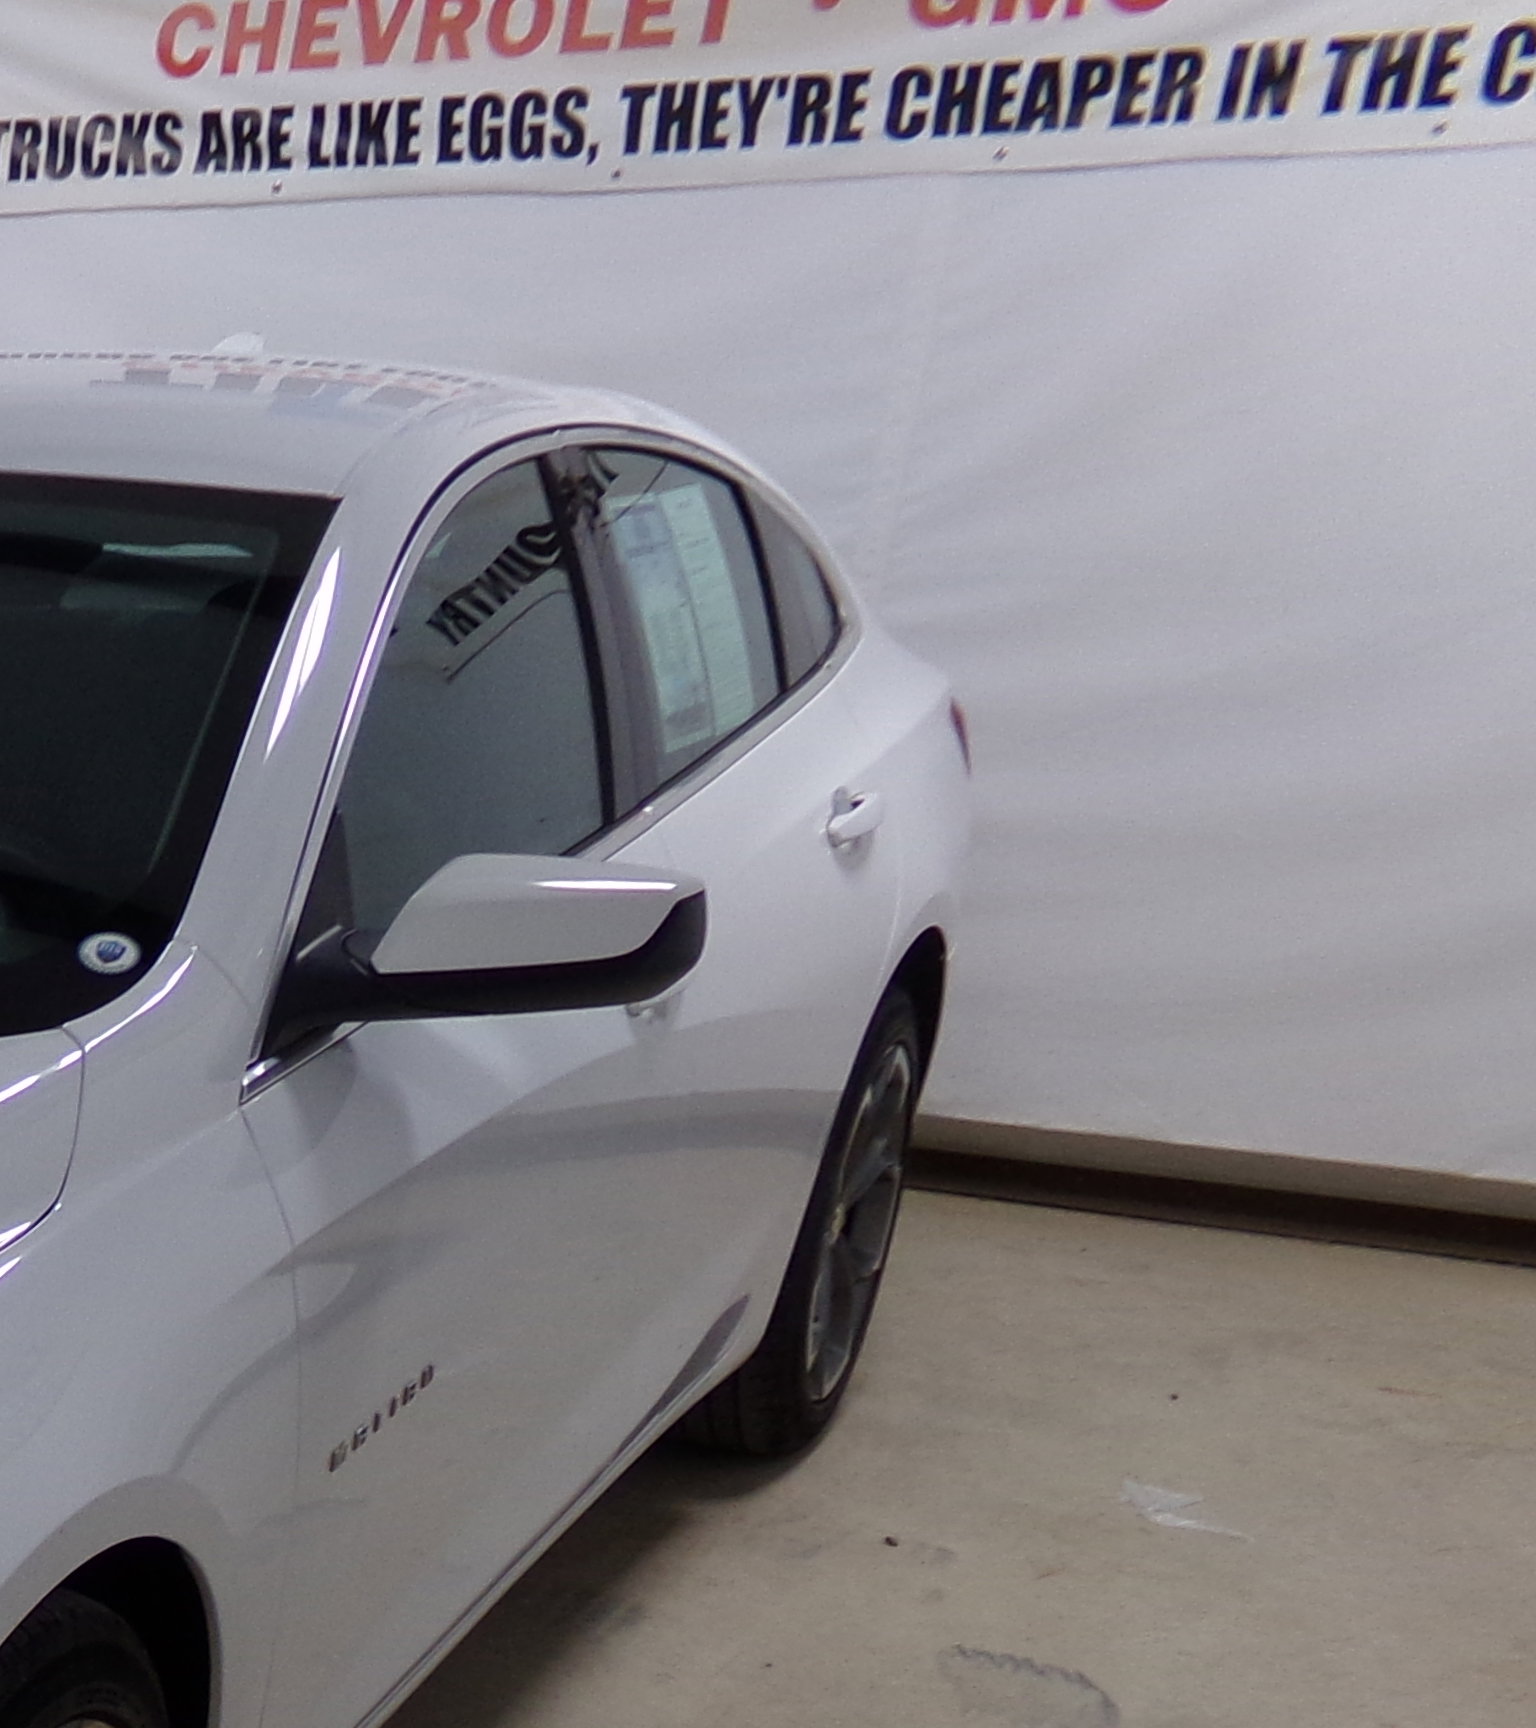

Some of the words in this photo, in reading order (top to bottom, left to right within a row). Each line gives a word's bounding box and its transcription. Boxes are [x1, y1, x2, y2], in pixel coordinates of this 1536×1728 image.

[194, 105, 295, 174] ARE
[307, 97, 424, 168] LIKE
[436, 86, 599, 166] EGGS,
[620, 67, 873, 156] THEY'RE
[883, 45, 1207, 140] CHEAPER
[1215, 38, 1308, 121] IN
[1320, 24, 1474, 115] THE
